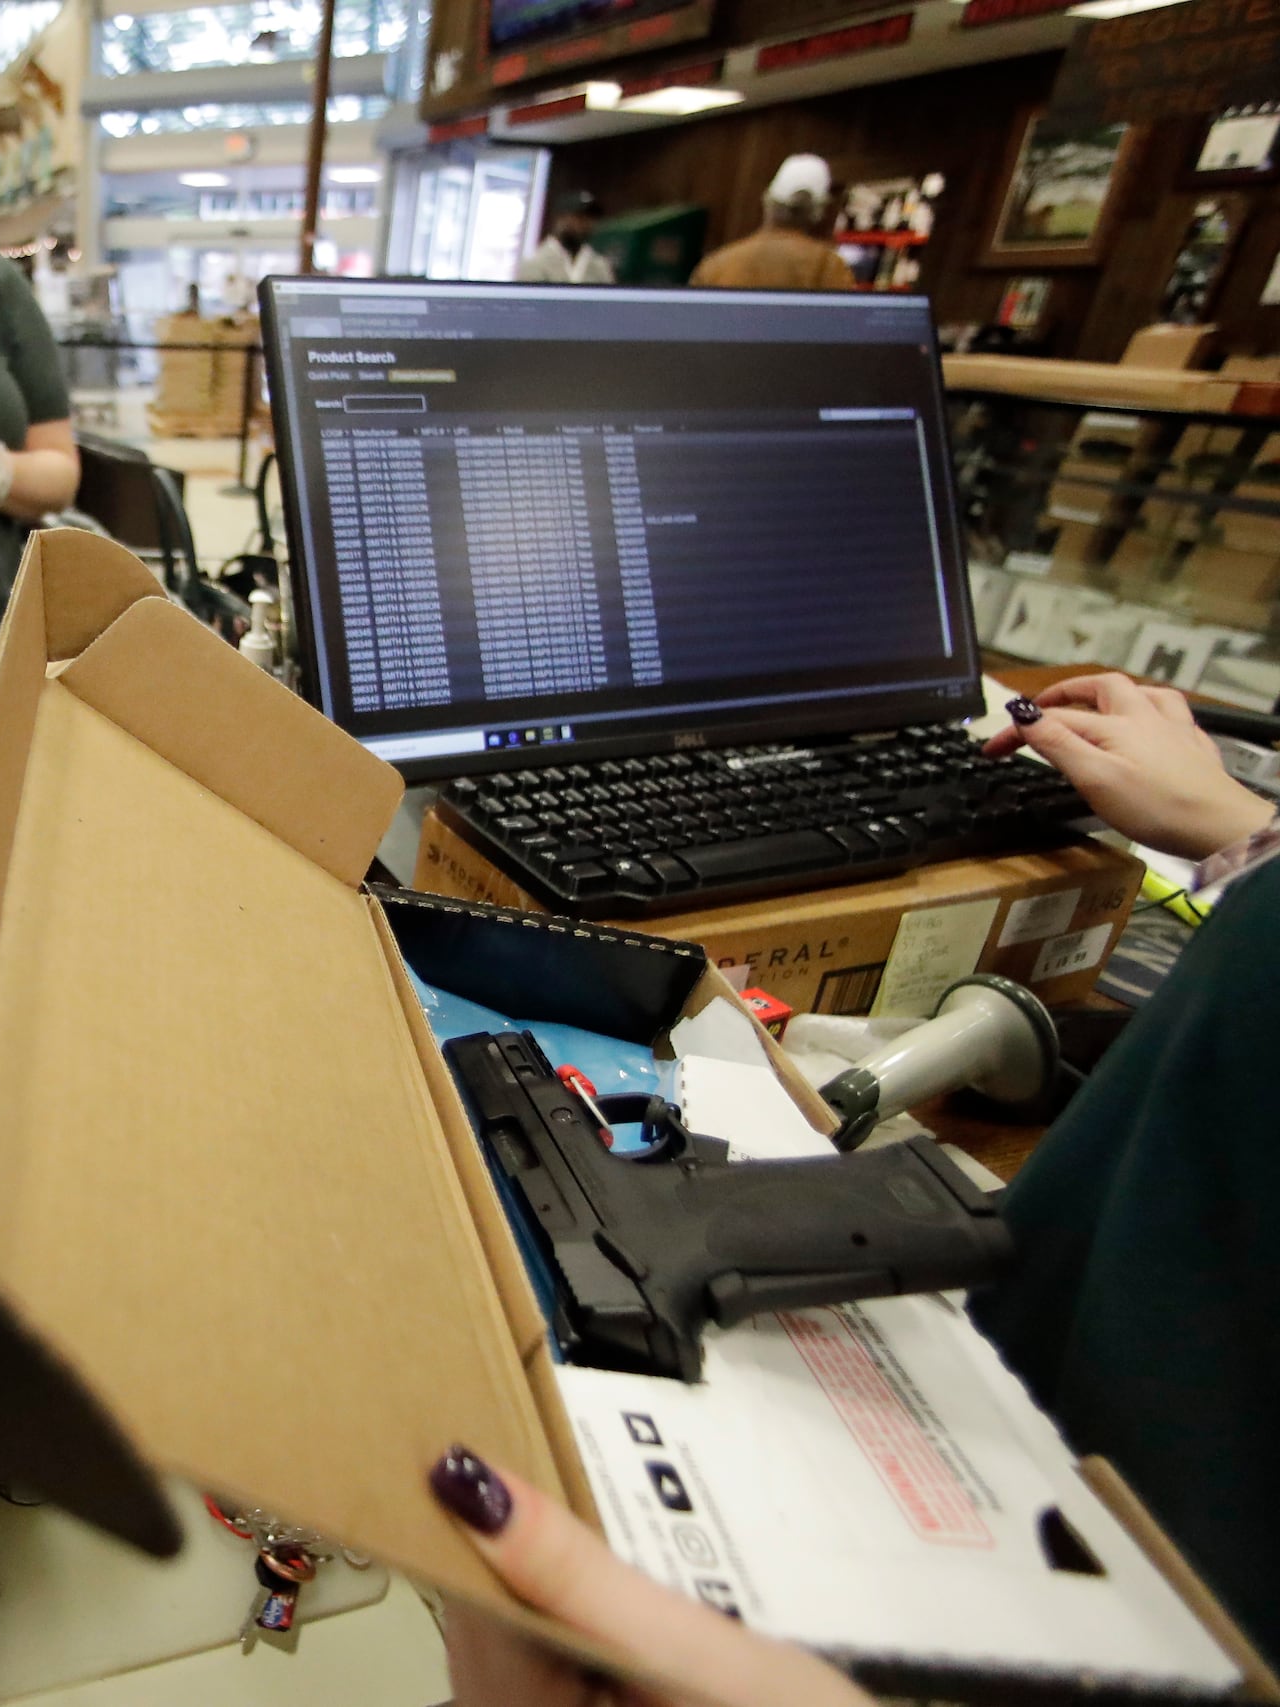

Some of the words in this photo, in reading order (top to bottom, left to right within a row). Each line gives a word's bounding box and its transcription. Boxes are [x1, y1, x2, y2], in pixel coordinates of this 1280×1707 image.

[307, 351, 353, 364] Product
[356, 352, 396, 365] Search
[674, 732, 707, 749] DELL
